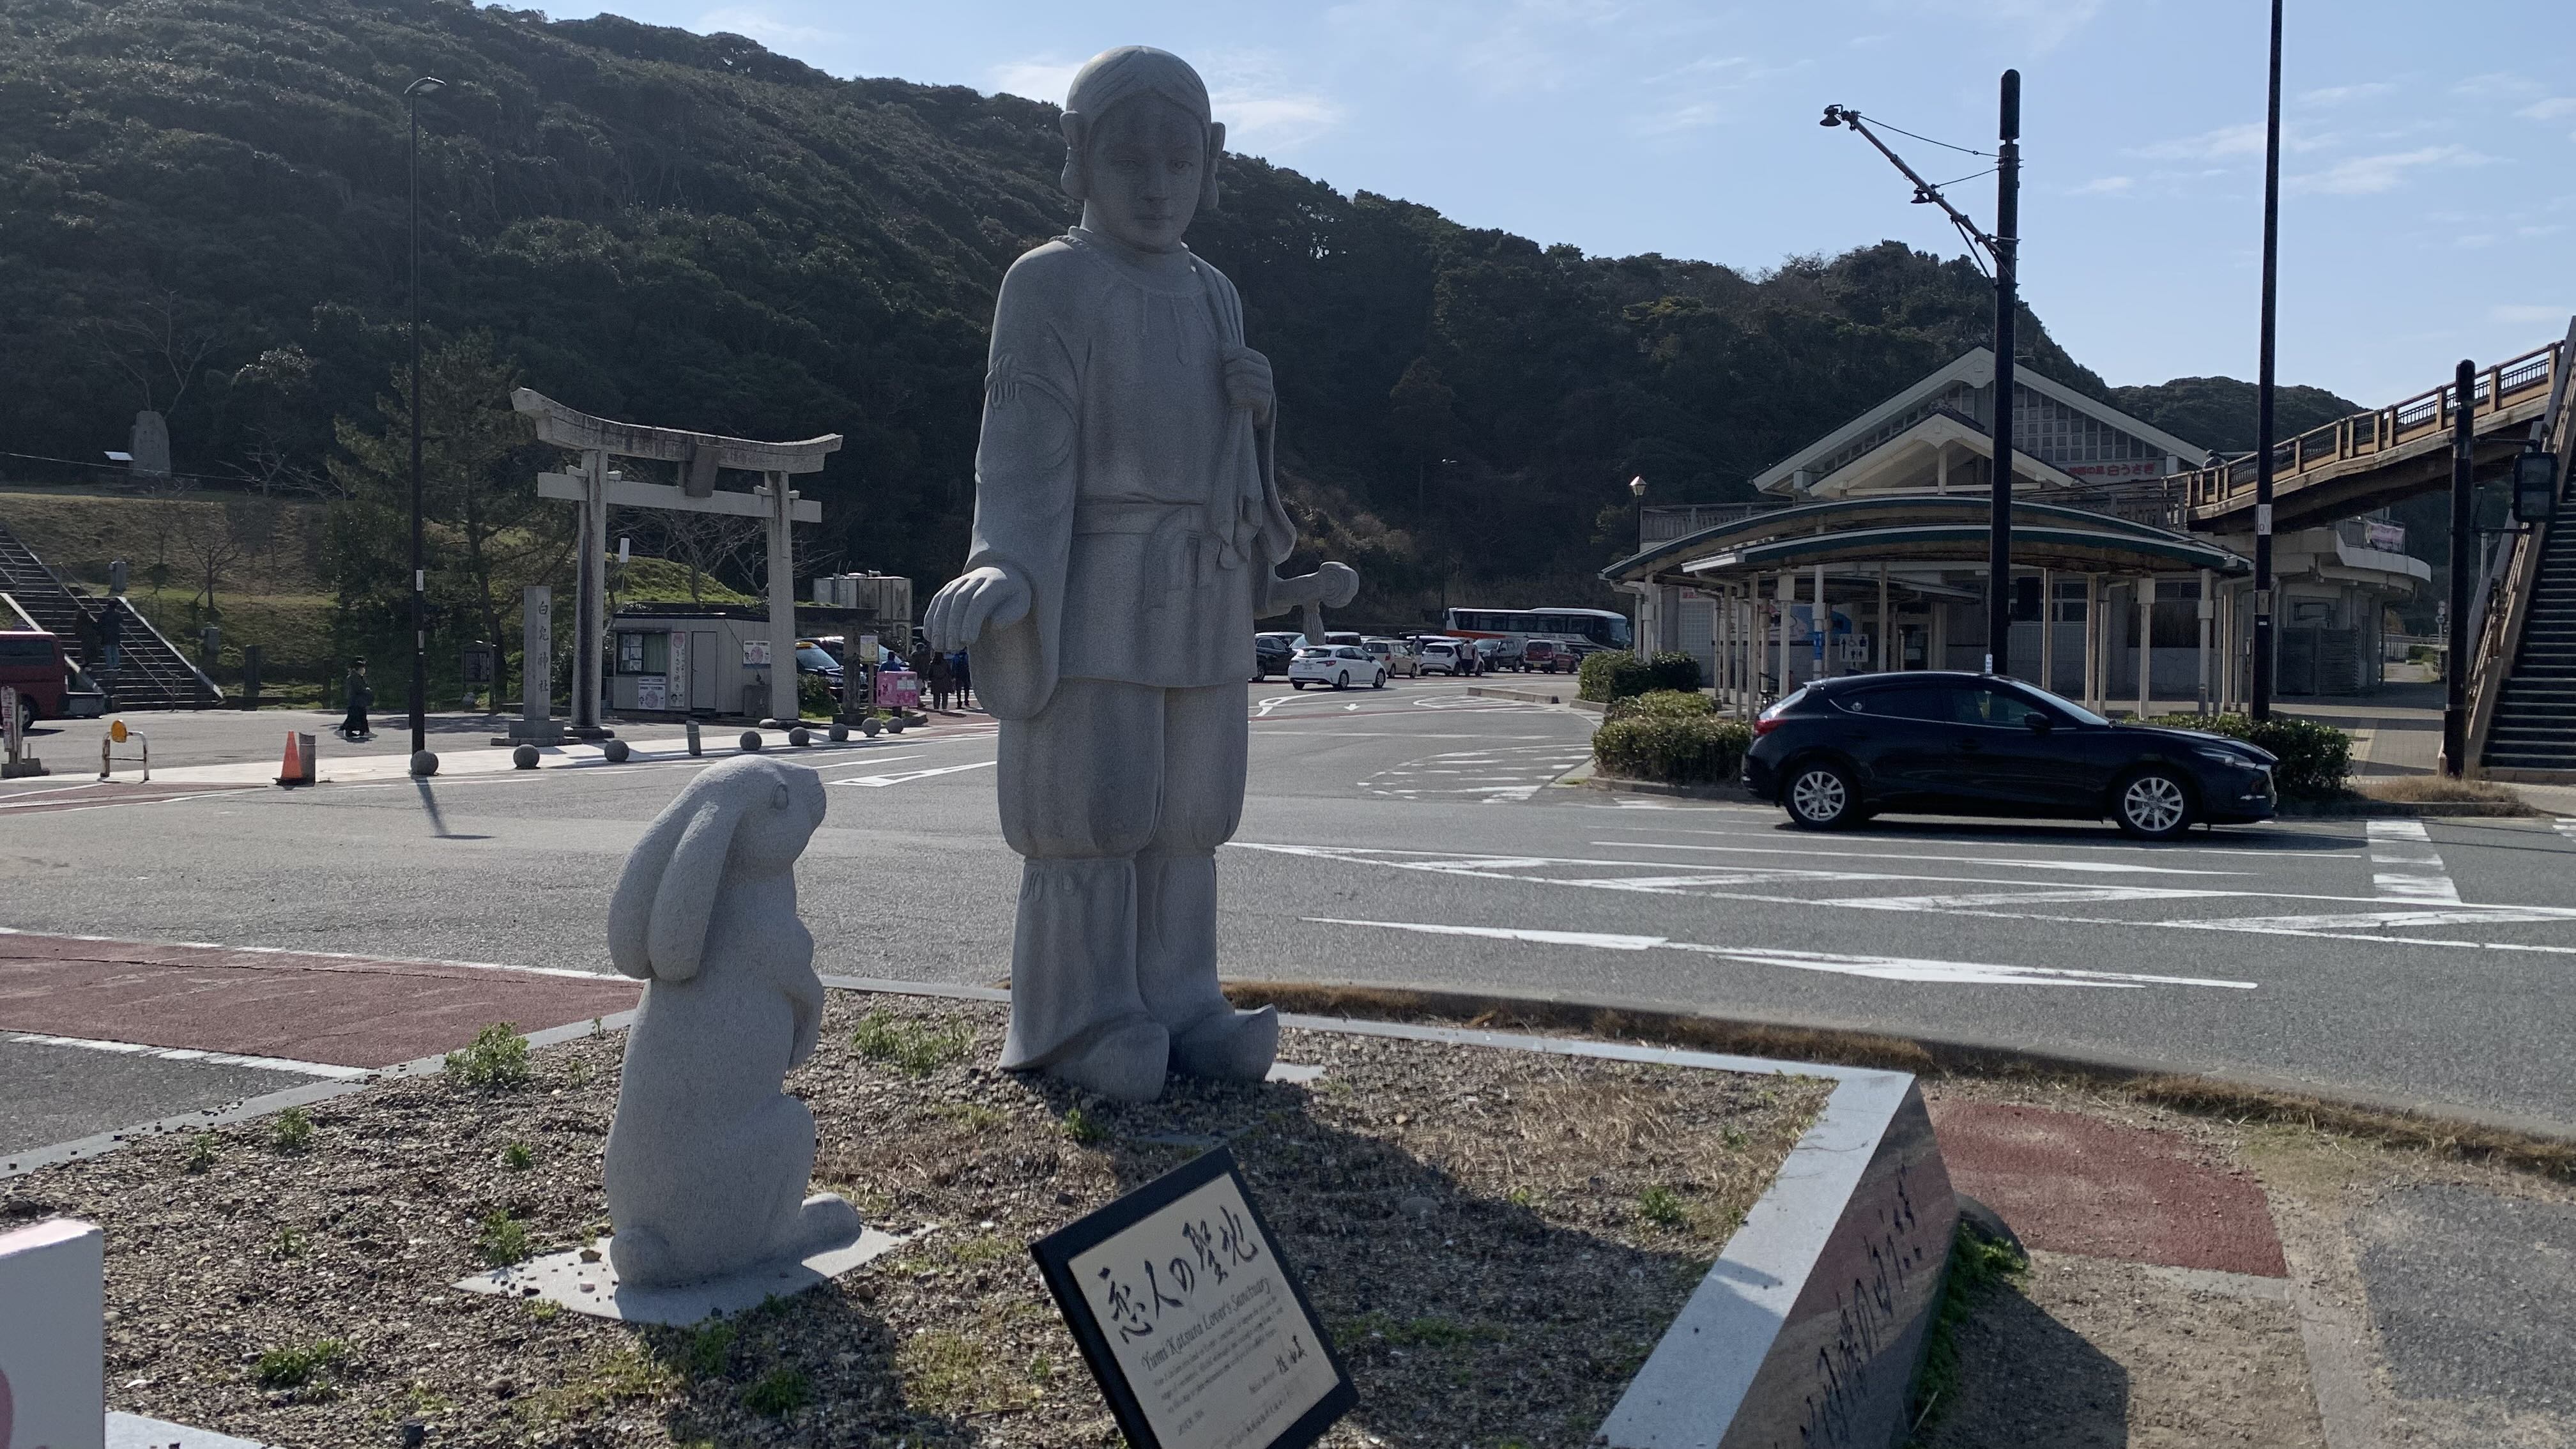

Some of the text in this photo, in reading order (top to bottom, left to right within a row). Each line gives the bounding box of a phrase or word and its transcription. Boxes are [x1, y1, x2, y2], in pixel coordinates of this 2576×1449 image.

[1098, 1206, 1258, 1344] 恋人の聖地
[1166, 1323, 1203, 1355] Katsura
[1230, 1277, 1271, 1312] Sanctuary
